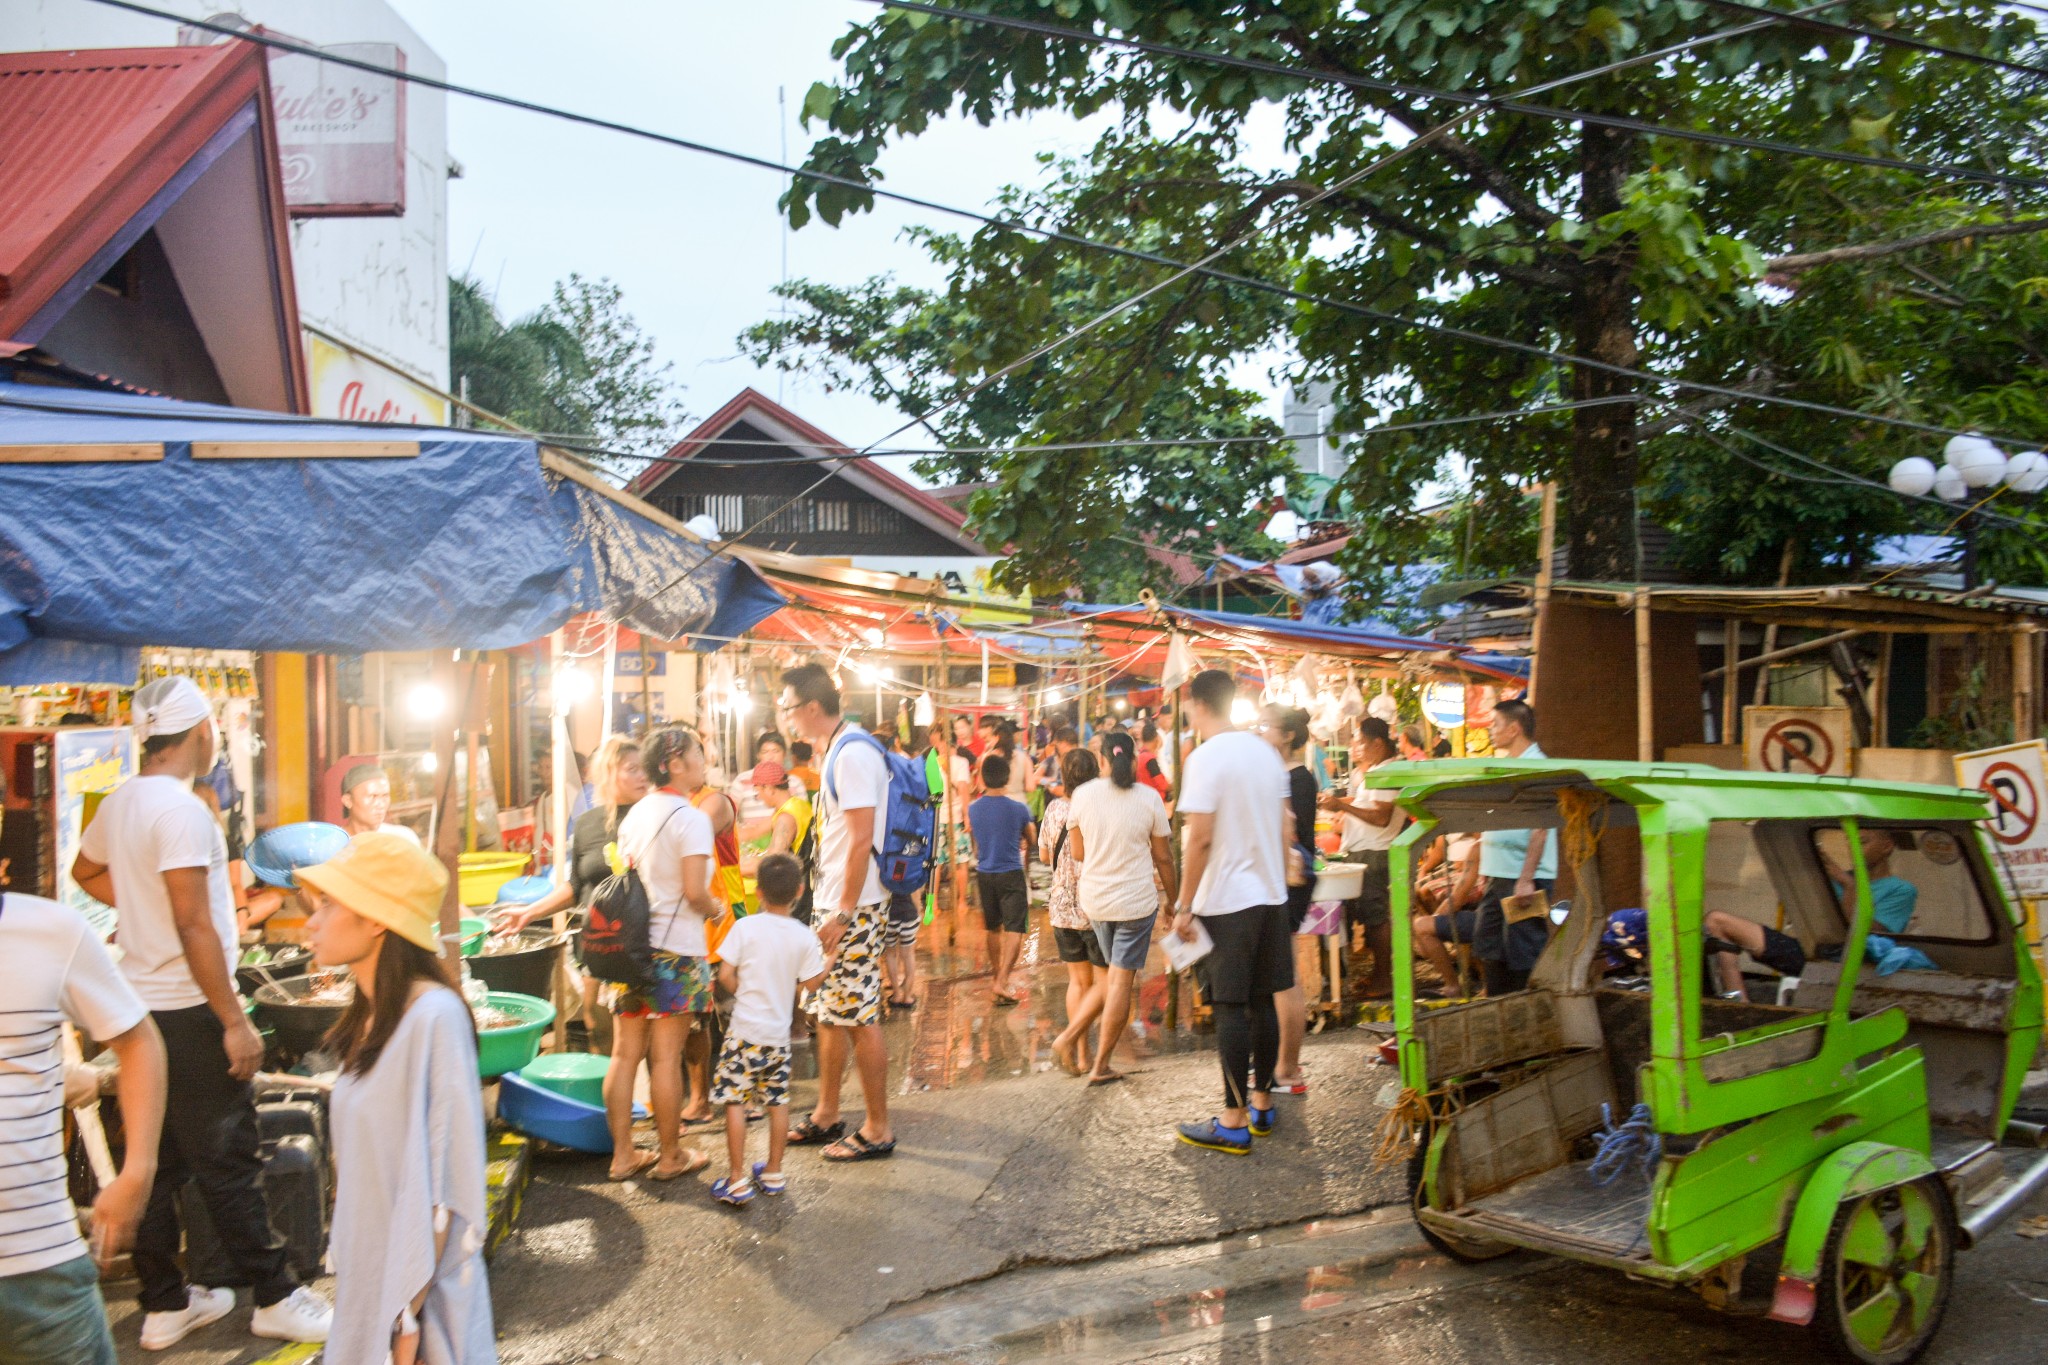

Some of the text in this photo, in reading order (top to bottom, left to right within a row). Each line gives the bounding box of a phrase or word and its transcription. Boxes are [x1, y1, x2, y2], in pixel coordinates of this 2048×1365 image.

[620, 655, 657, 673] BDO
[1782, 731, 1814, 773] P
[1991, 777, 2019, 832] P
